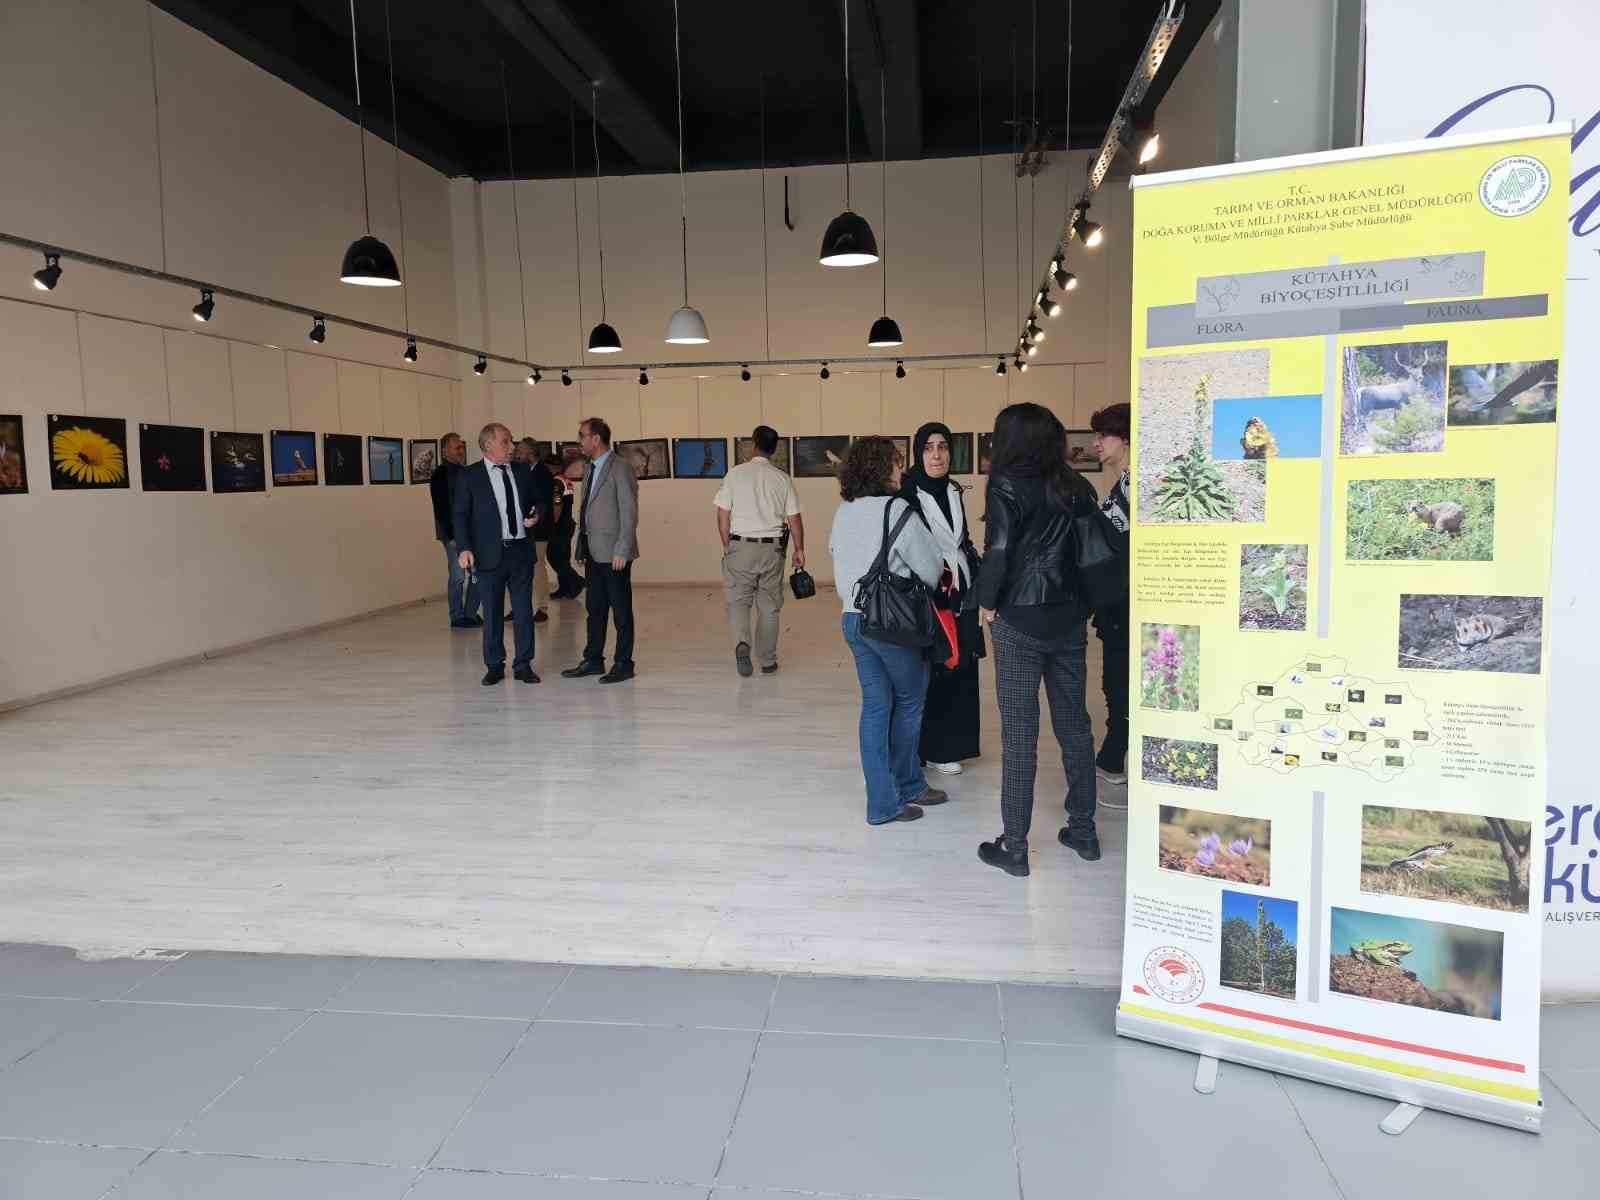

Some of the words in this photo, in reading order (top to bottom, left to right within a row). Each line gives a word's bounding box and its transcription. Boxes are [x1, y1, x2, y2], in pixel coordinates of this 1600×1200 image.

[1215, 203, 1253, 217] TARIM
[1256, 199, 1274, 211] VE
[1276, 194, 1325, 209] ORMAN
[1329, 184, 1406, 201] BAKANLIĞI
[1142, 228, 1175, 239] DOĞA
[1177, 220, 1227, 234] KORUMA
[1230, 218, 1246, 228] VE
[1283, 207, 1339, 223] PARKLAR
[1342, 203, 1385, 216] GENEL
[1387, 191, 1473, 211] MÜDÜRLÜĞÜ
[1287, 221, 1327, 234] Kütahya
[1291, 267, 1377, 286] KÜTAHYA
[1260, 278, 1409, 304] BİYOÇEŞİTLİLİĞİ
[1426, 304, 1482, 318] FAUNA
[1197, 320, 1244, 336] FLORA
